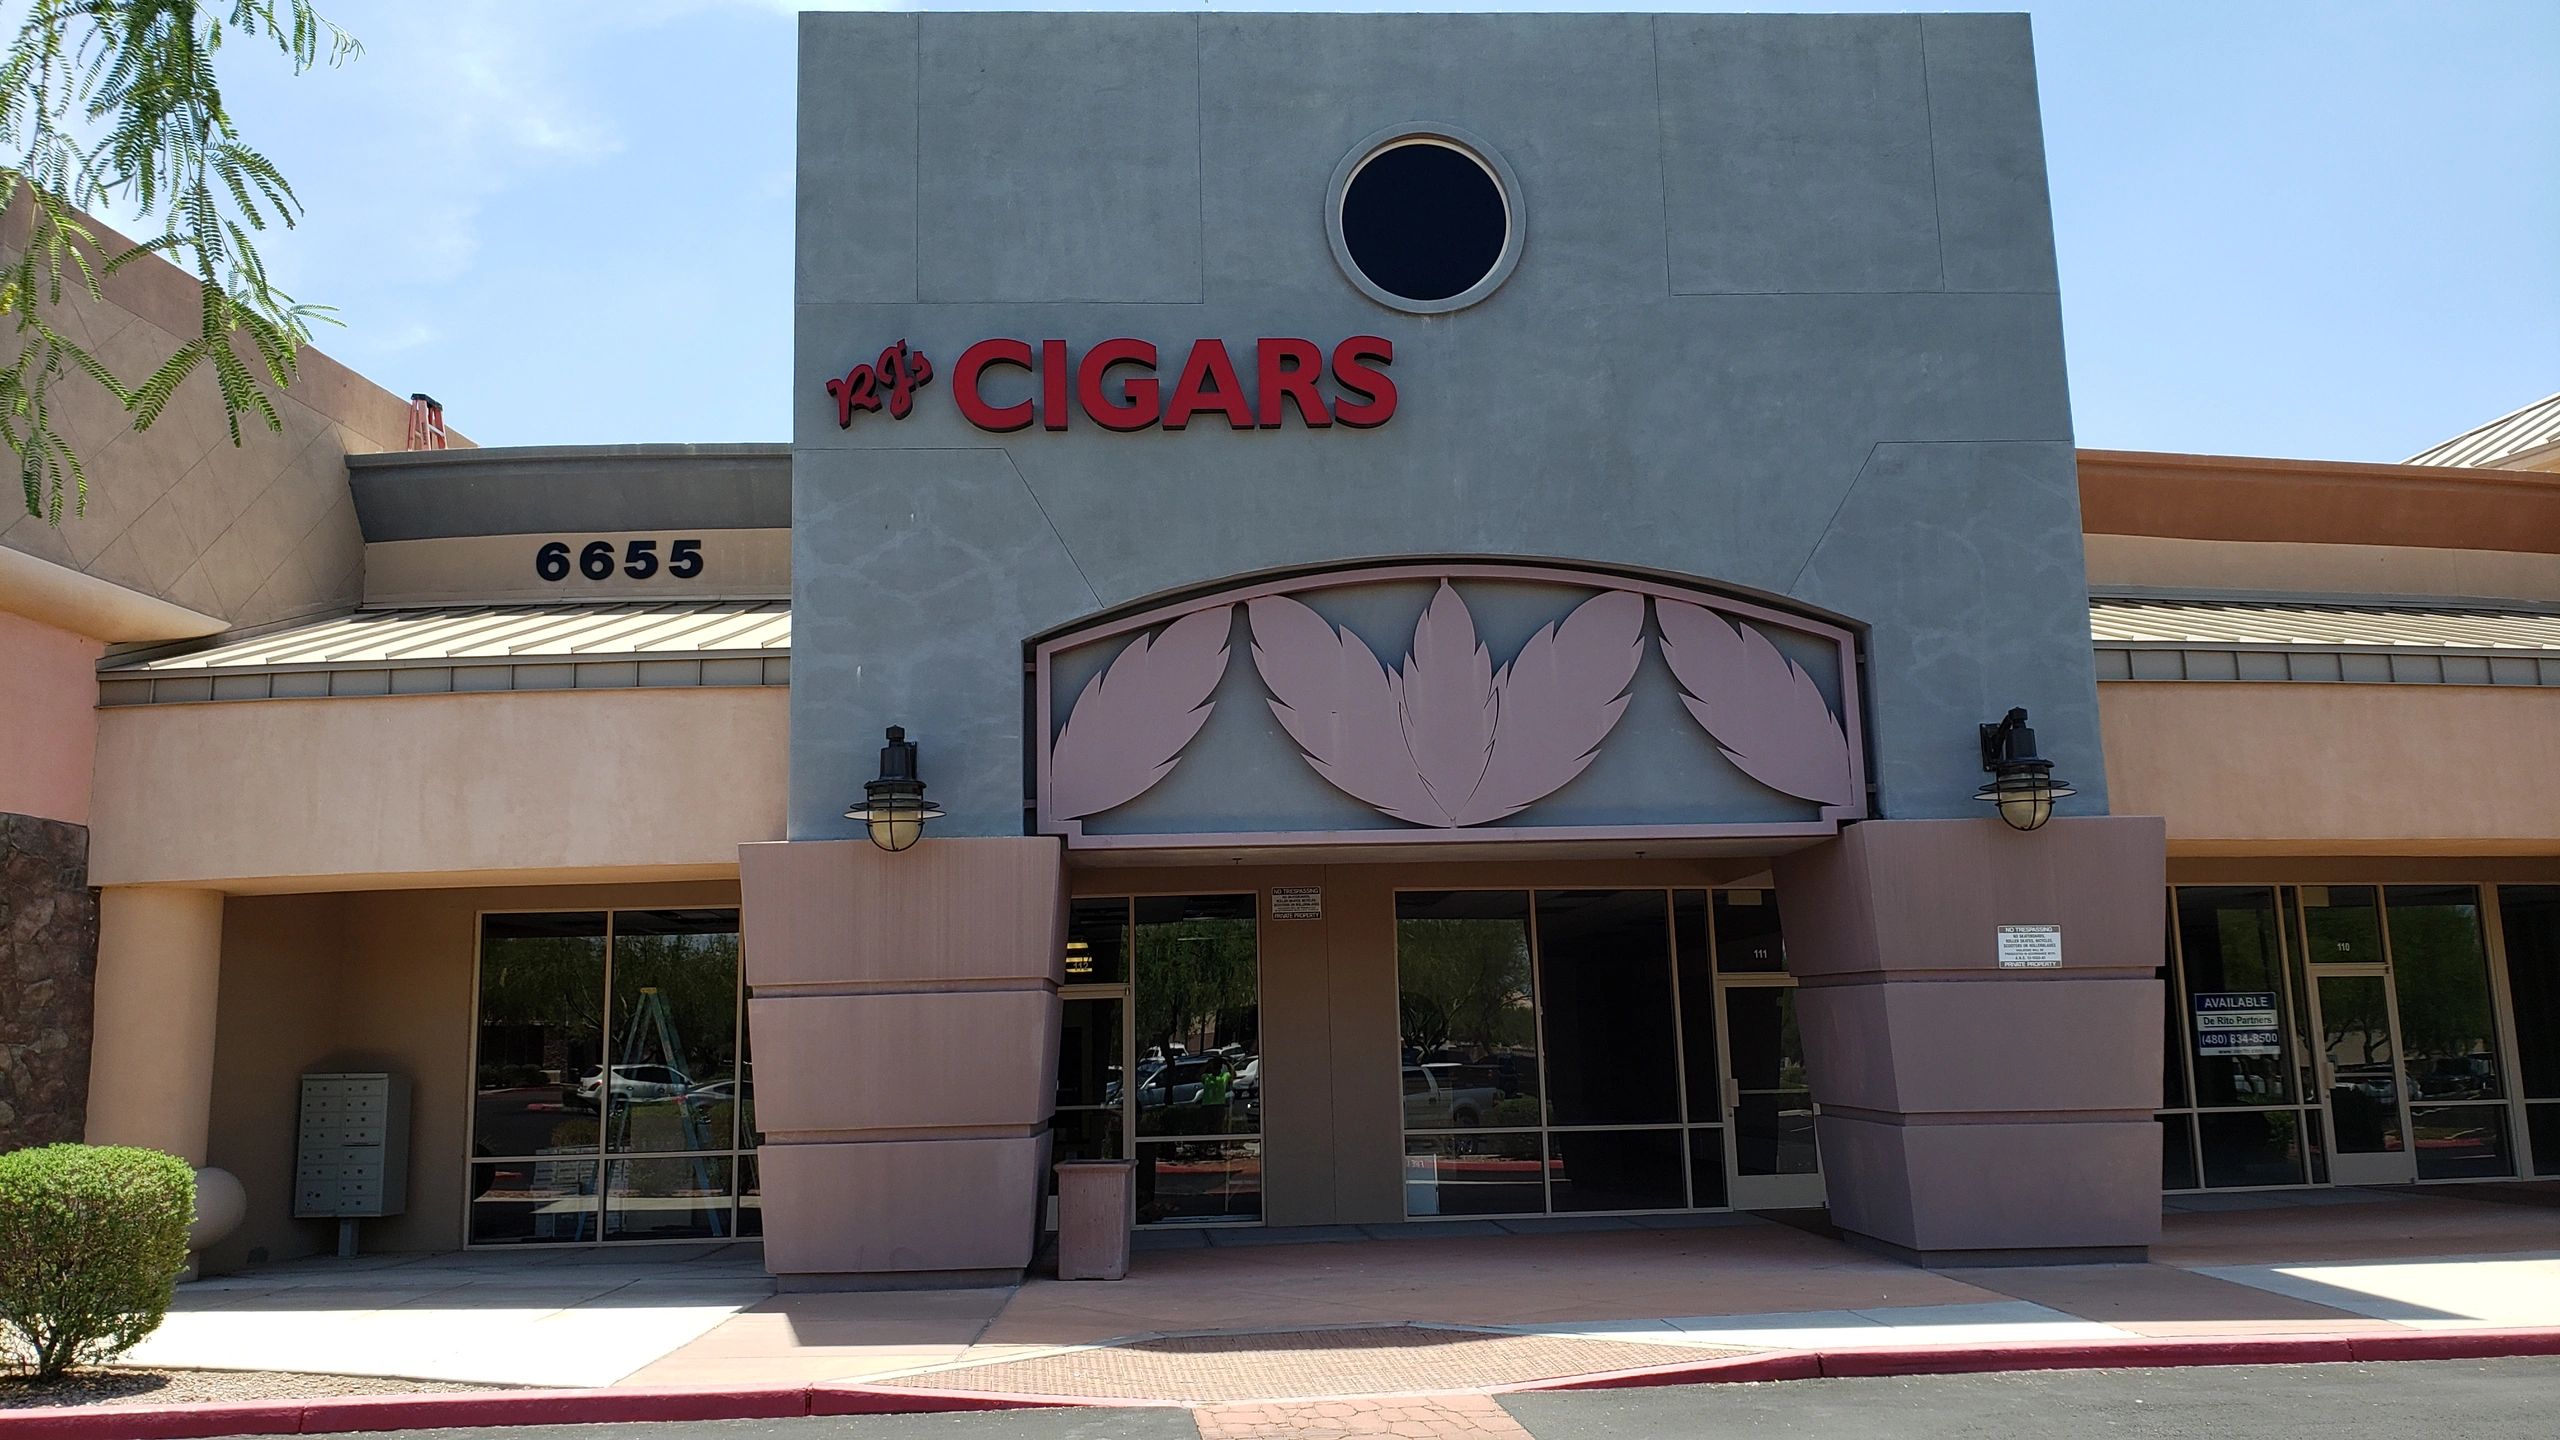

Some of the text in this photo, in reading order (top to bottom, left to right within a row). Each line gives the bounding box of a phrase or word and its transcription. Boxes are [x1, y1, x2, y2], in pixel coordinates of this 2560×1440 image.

[952, 335, 1398, 432] CIGARS
[536, 539, 704, 581] 6655
[2337, 942, 2350, 951] 110
[1753, 949, 1767, 959] 111
[1073, 962, 1089, 971] 112
[2204, 996, 2268, 1008] AVAILABLE
[2203, 1016, 2272, 1025] De Rito Partners
[2202, 1034, 2227, 1045] (480)
